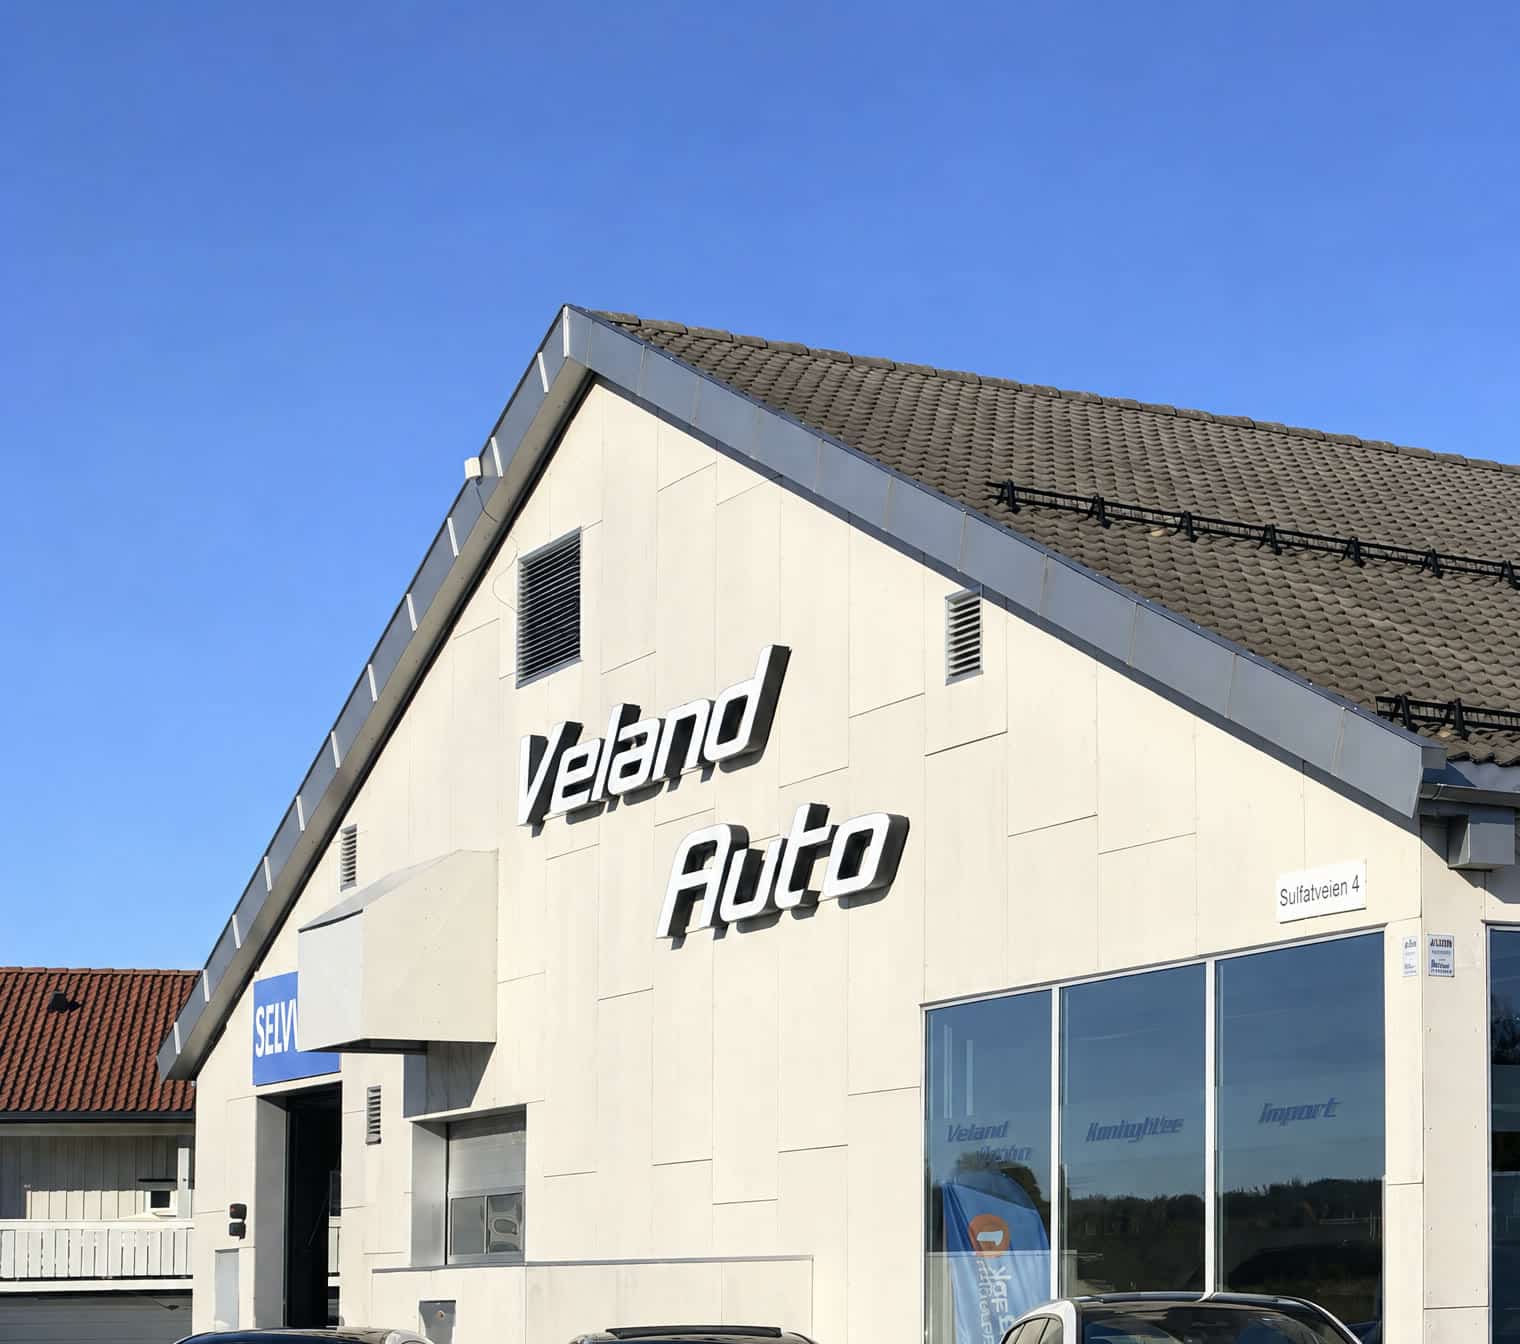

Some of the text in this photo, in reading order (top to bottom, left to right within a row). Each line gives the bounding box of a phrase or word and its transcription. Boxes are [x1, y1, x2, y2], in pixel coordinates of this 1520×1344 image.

[519, 644, 791, 827] Veland
[656, 803, 909, 939] Auto
[1279, 873, 1360, 907] Sulfatveien 4
[1259, 1097, 1342, 1127] Import
[947, 1120, 1009, 1143] Veland
